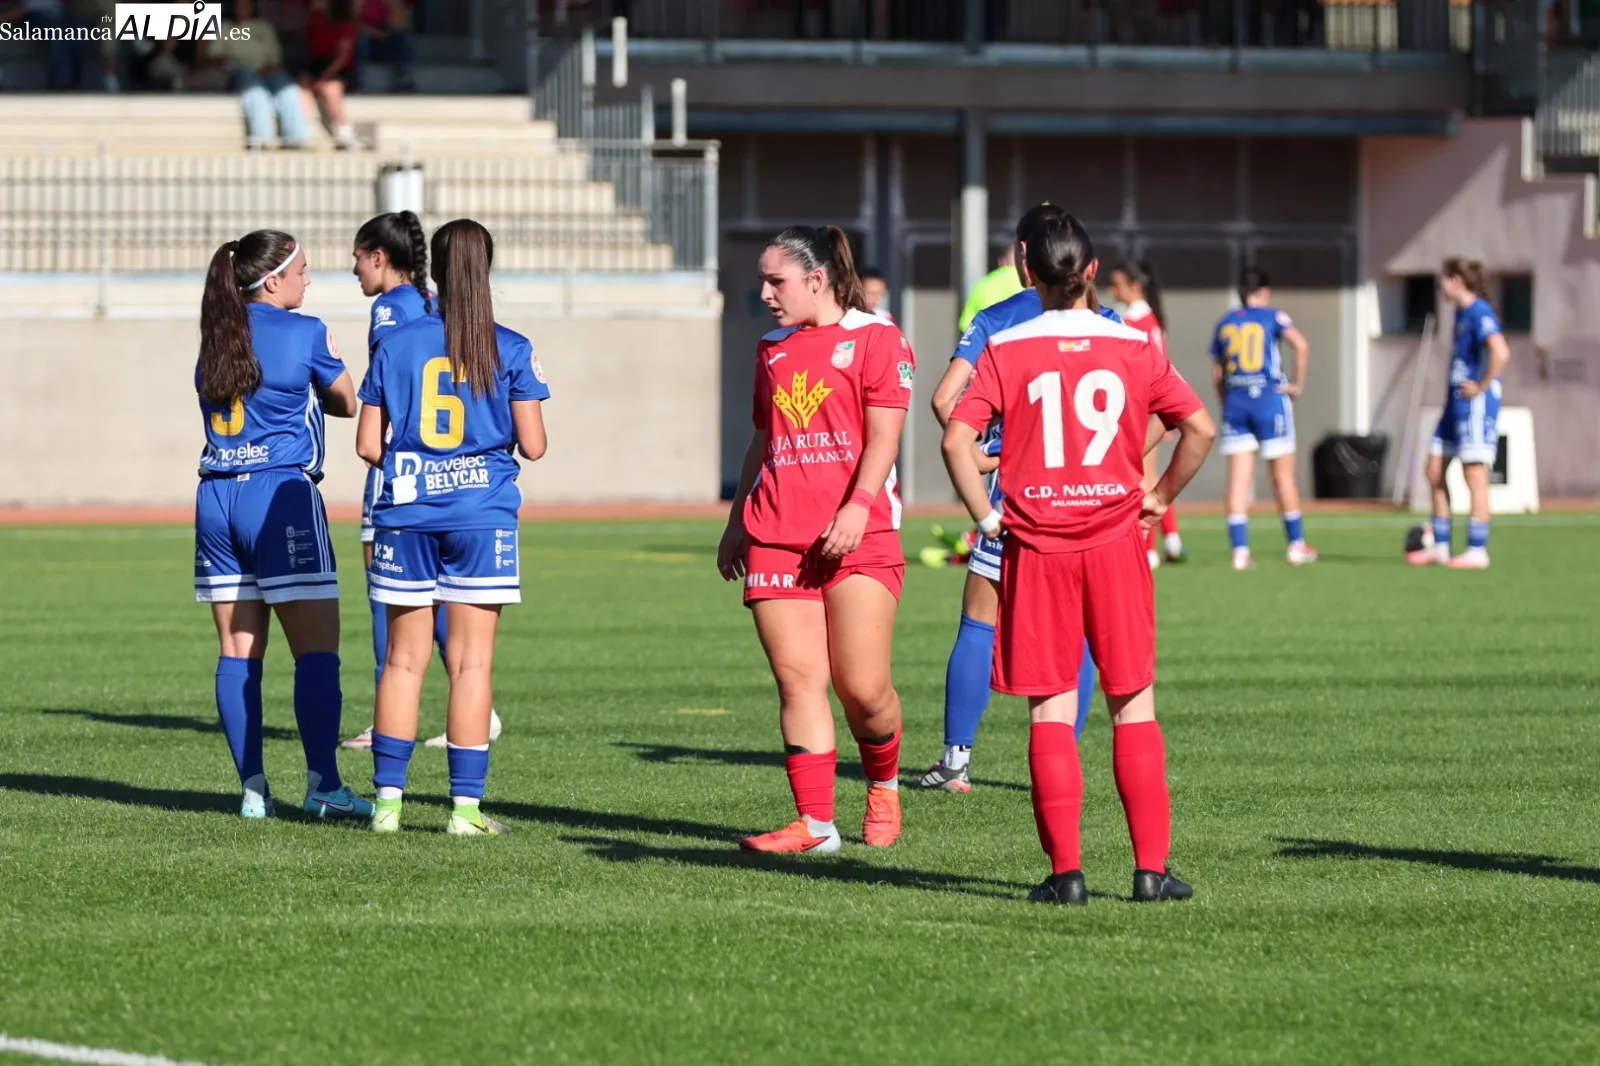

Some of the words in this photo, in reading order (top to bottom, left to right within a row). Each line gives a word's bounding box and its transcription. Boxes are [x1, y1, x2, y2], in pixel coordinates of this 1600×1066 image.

[1220, 321, 1265, 374] 20
[420, 356, 467, 449] 6
[1027, 368, 1126, 469] 19
[795, 431, 852, 449] RURAL
[424, 454, 487, 473] novelec
[773, 449, 854, 467] SALAMANCA
[425, 468, 490, 491] BELYCAR
[1024, 486, 1058, 499] C.D.
[1063, 483, 1128, 497] NAVEGA
[1050, 498, 1102, 507] SALAMANCA
